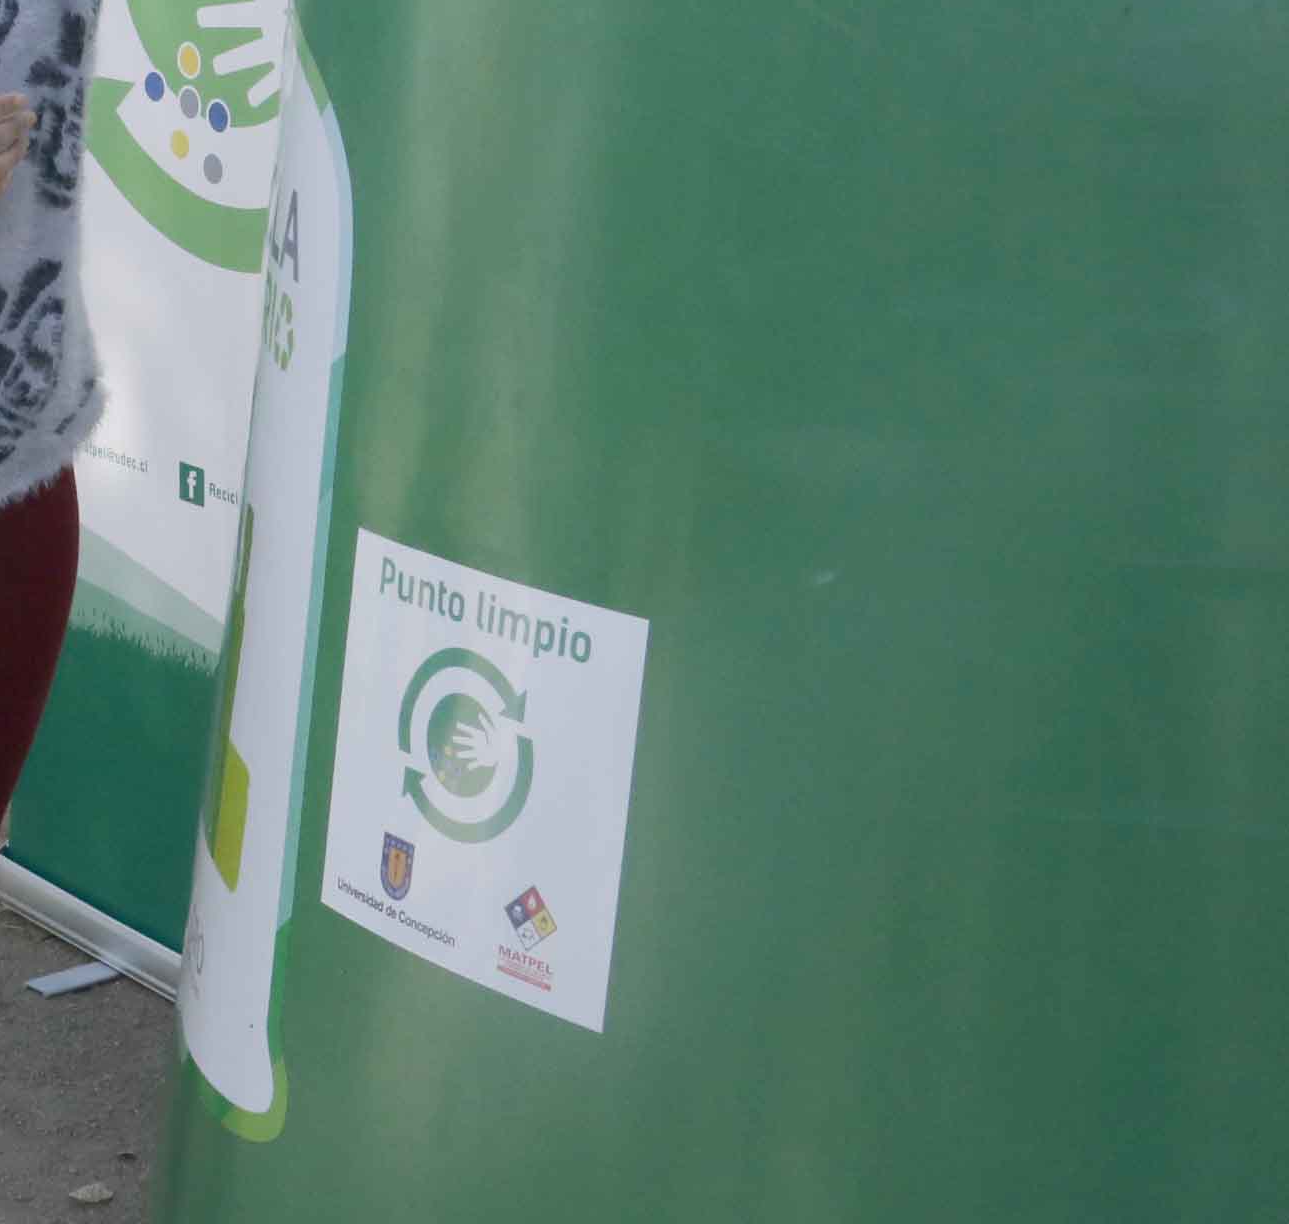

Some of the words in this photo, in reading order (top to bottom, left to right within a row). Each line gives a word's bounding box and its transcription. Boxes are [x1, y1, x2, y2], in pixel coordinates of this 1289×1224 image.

[379, 556, 465, 622] Punto
[476, 591, 592, 664] limpio
[337, 876, 384, 913] Universidad
[385, 904, 398, 920] de
[398, 910, 456, 948] Concepción
[498, 943, 554, 977] MATPEL
